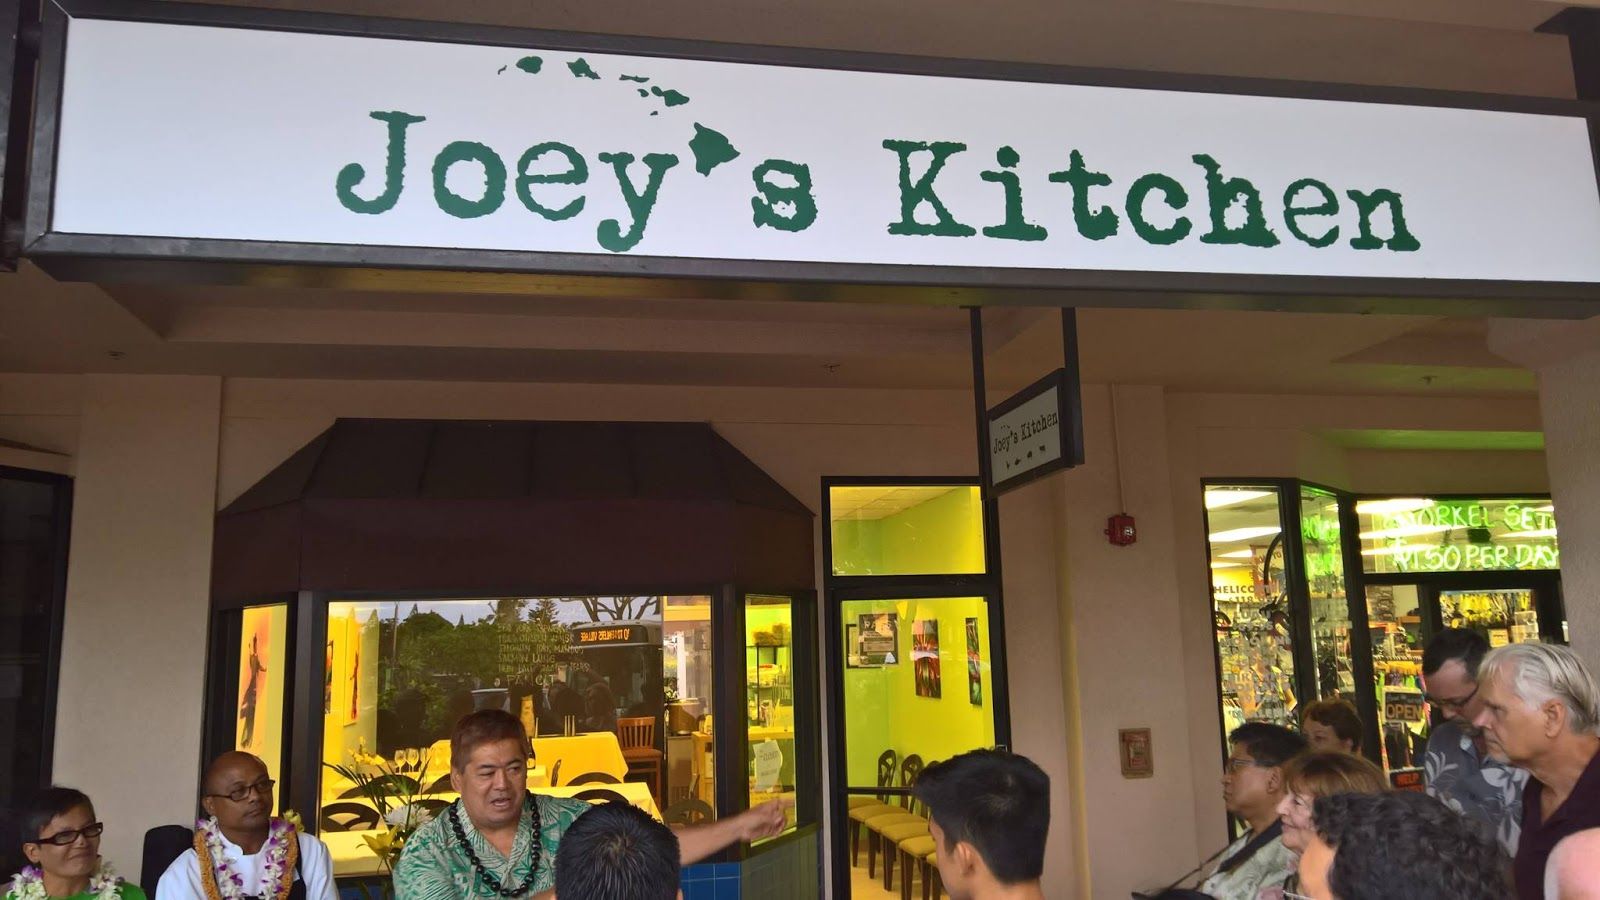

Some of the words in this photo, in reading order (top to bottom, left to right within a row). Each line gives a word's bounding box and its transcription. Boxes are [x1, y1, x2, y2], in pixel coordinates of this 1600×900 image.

[336, 111, 817, 253] Joey's
[883, 138, 1421, 252] Kitchen
[993, 430, 1018, 455] Joey's
[1020, 411, 1058, 441] Kitchen
[1384, 504, 1494, 528] ORKEL
[1465, 545, 1508, 568] PER
[1515, 543, 1559, 567] DAY
[1386, 703, 1422, 720] OPEN
